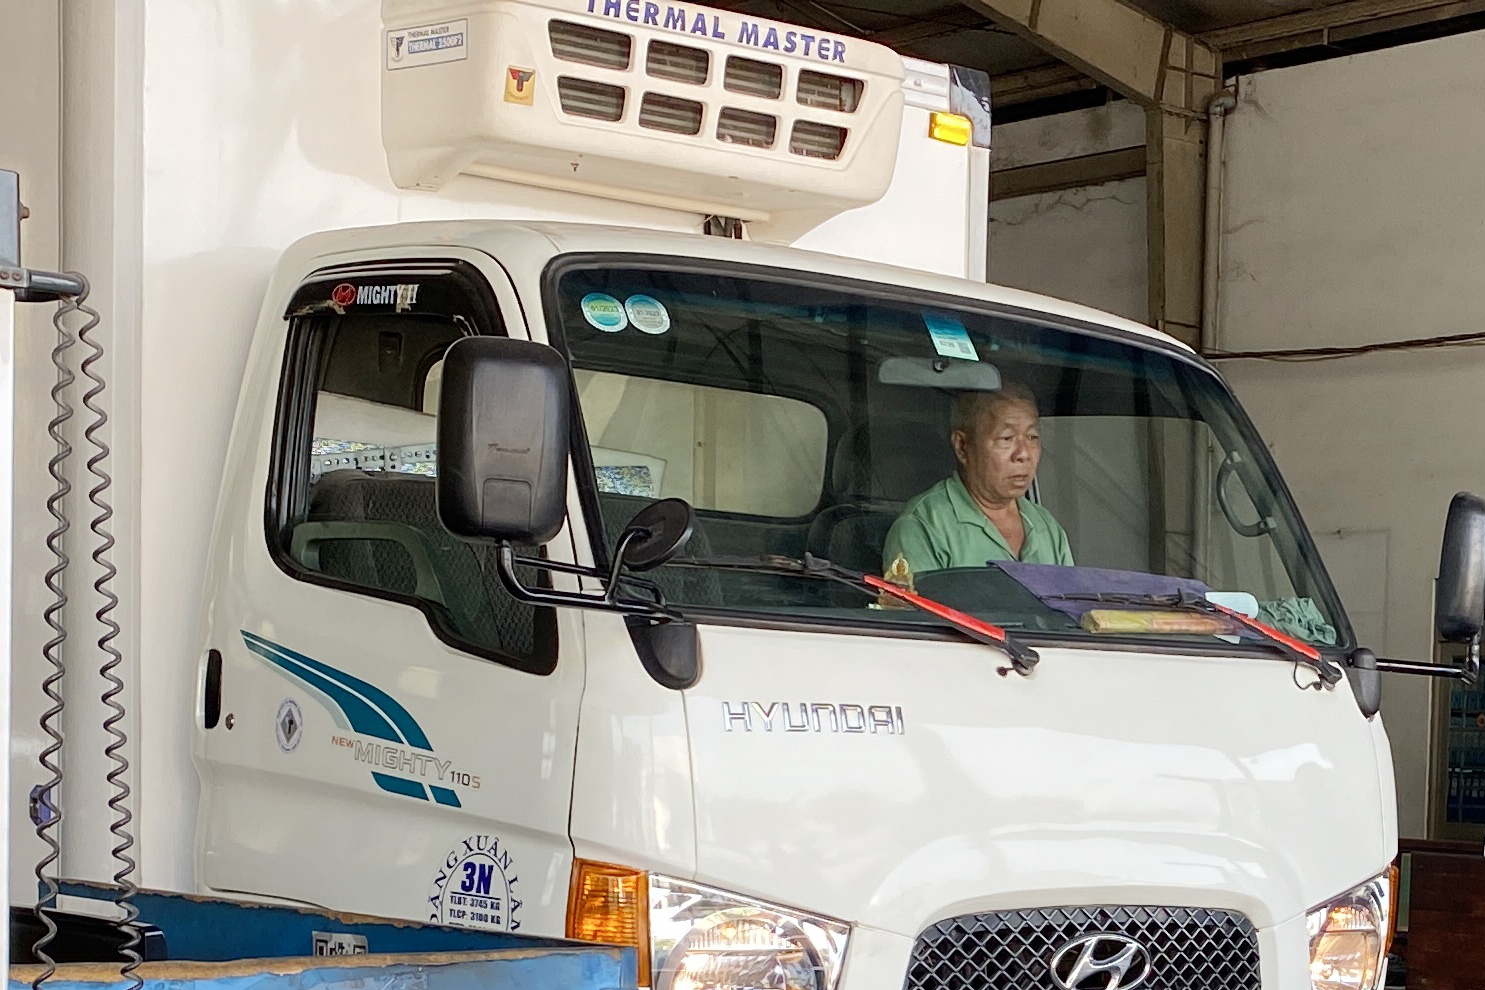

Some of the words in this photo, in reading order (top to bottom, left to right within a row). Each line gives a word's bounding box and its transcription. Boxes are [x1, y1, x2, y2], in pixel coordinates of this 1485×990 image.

[737, 21, 847, 64] MASTER
[357, 285, 405, 305] MIGHTY
[722, 701, 905, 735] HYUNDAI
[331, 736, 354, 749] NEW
[354, 740, 452, 781] MIGHTY
[450, 771, 481, 789] 110S
[462, 835, 514, 871] XUÂN
[461, 861, 494, 895] 3N
